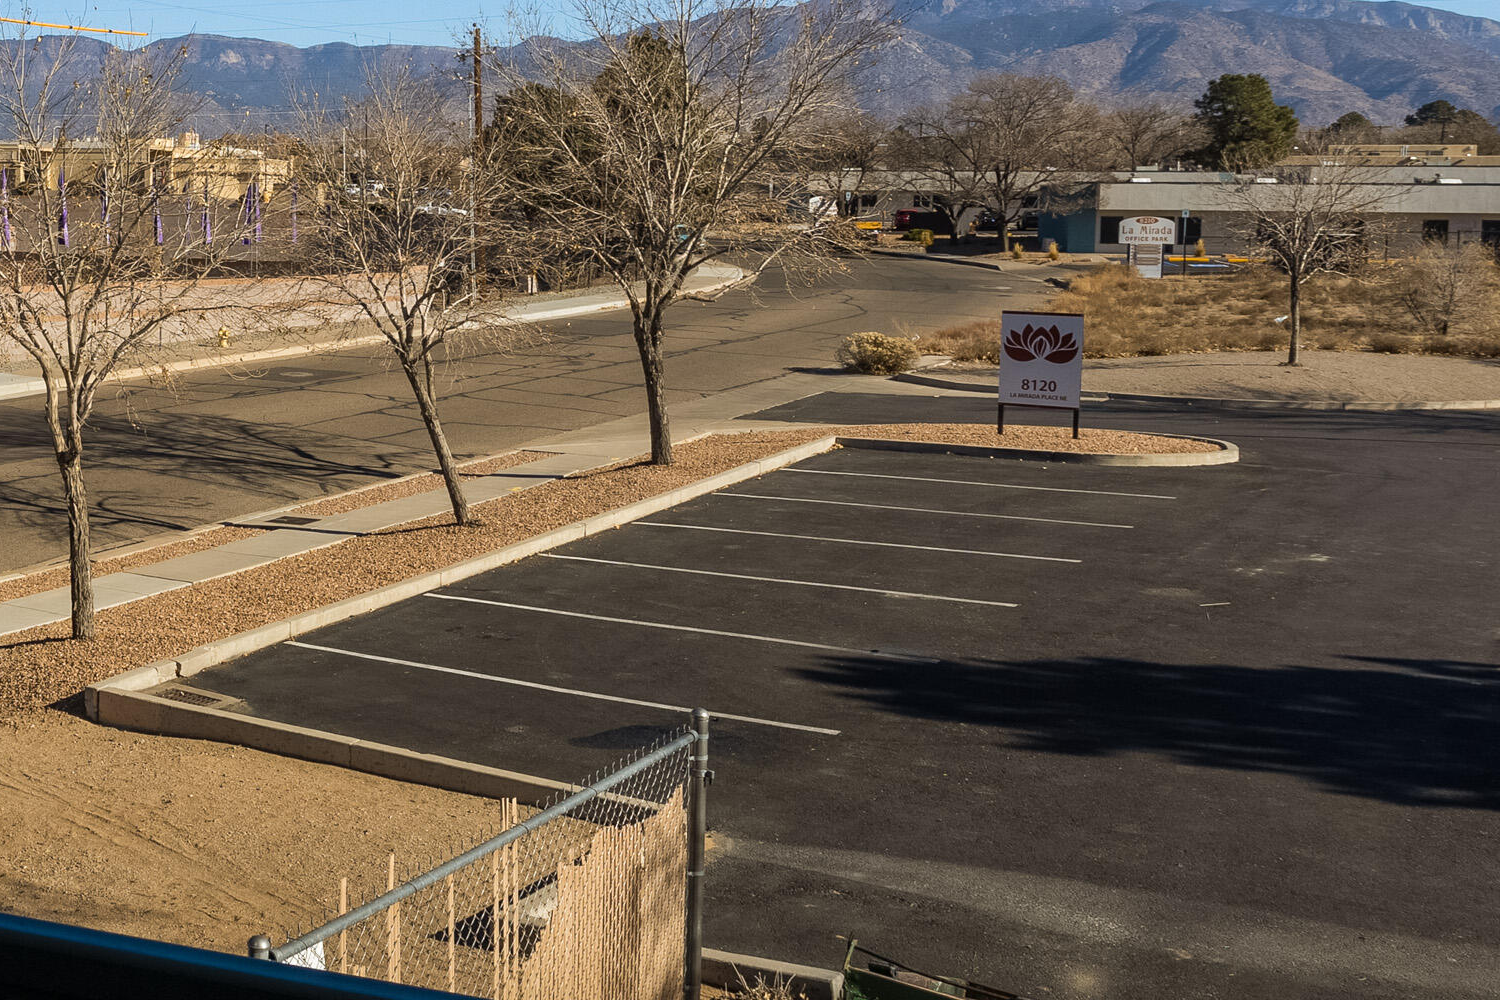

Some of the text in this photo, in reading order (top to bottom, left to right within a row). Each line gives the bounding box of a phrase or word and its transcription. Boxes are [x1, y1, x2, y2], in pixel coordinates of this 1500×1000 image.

[1122, 225, 1172, 235] La Mirada
[1021, 378, 1057, 392] 8120
[1018, 392, 1040, 400] MIRADA
